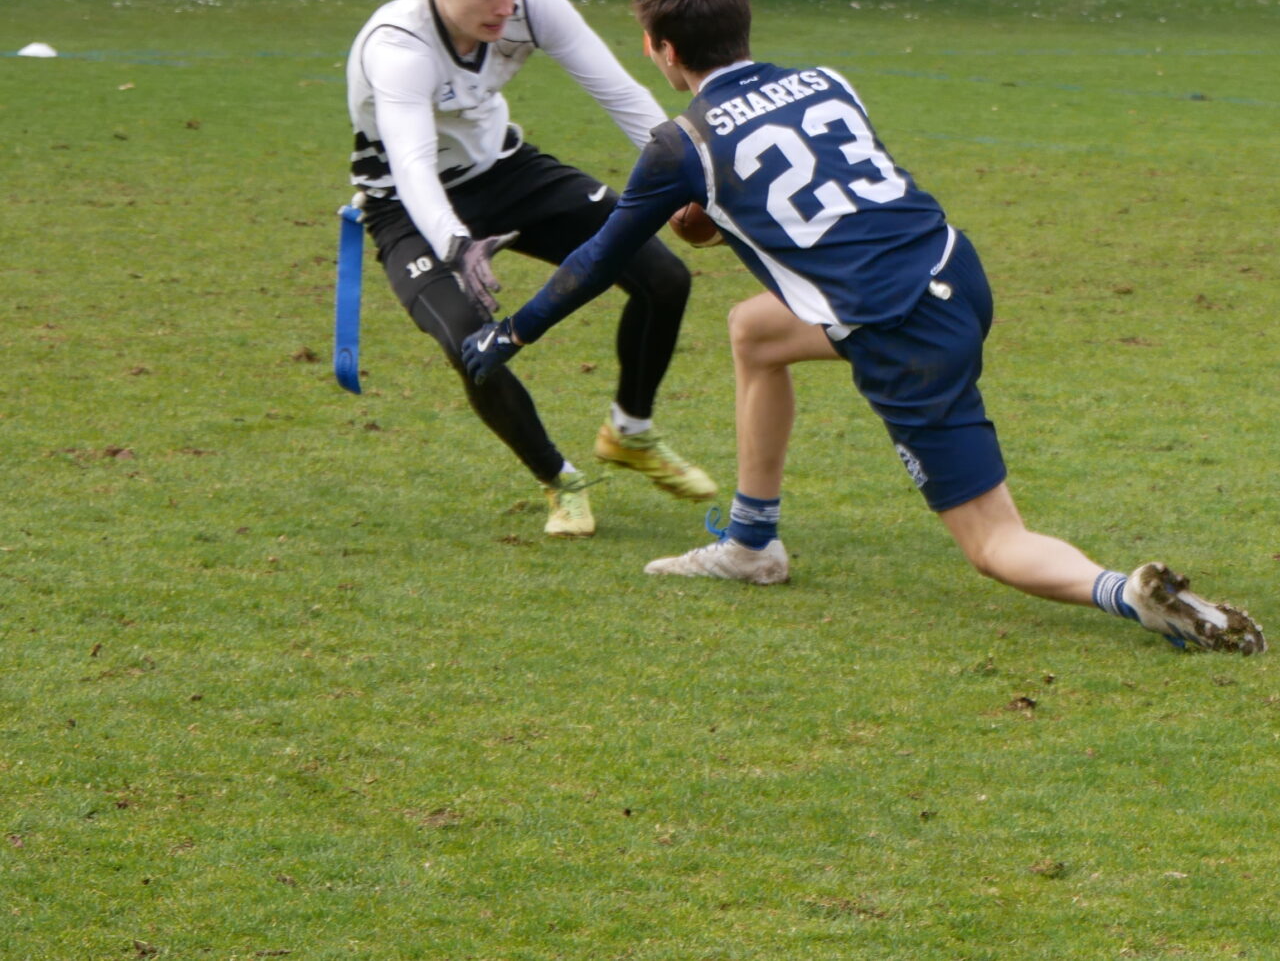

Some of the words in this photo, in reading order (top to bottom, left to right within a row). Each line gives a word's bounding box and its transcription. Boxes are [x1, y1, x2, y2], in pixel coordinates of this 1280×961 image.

[705, 69, 831, 137] SHARKS
[733, 98, 908, 249] 23
[405, 256, 433, 280] 10
